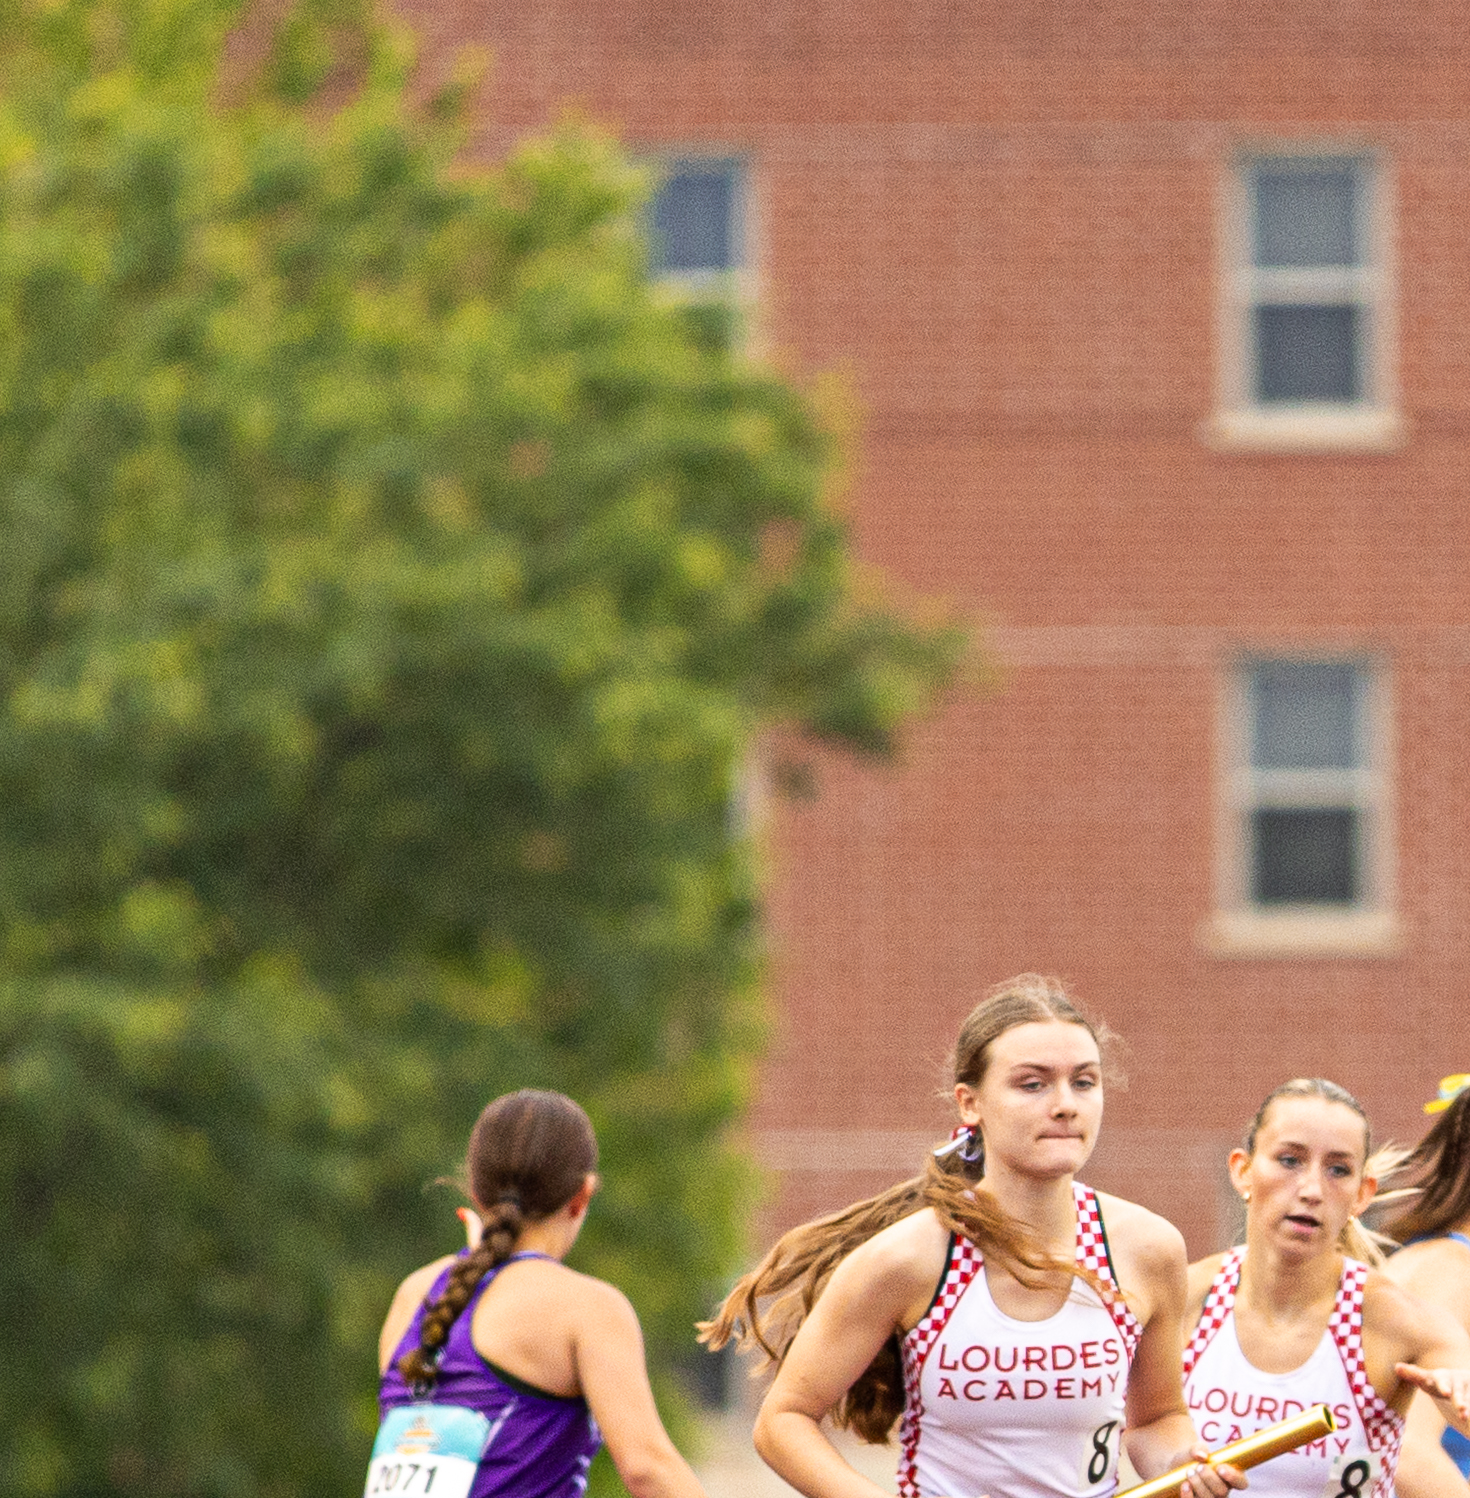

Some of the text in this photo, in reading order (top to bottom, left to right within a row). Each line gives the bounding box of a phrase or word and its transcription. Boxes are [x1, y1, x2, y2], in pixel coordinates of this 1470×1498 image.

[938, 1338, 1120, 1373] LOURDES
[937, 1370, 1120, 1401] ACADEMY
[1188, 1384, 1352, 1430] LOURDS
[1087, 1420, 1119, 1485] 8
[1200, 1420, 1351, 1459] CAMY
